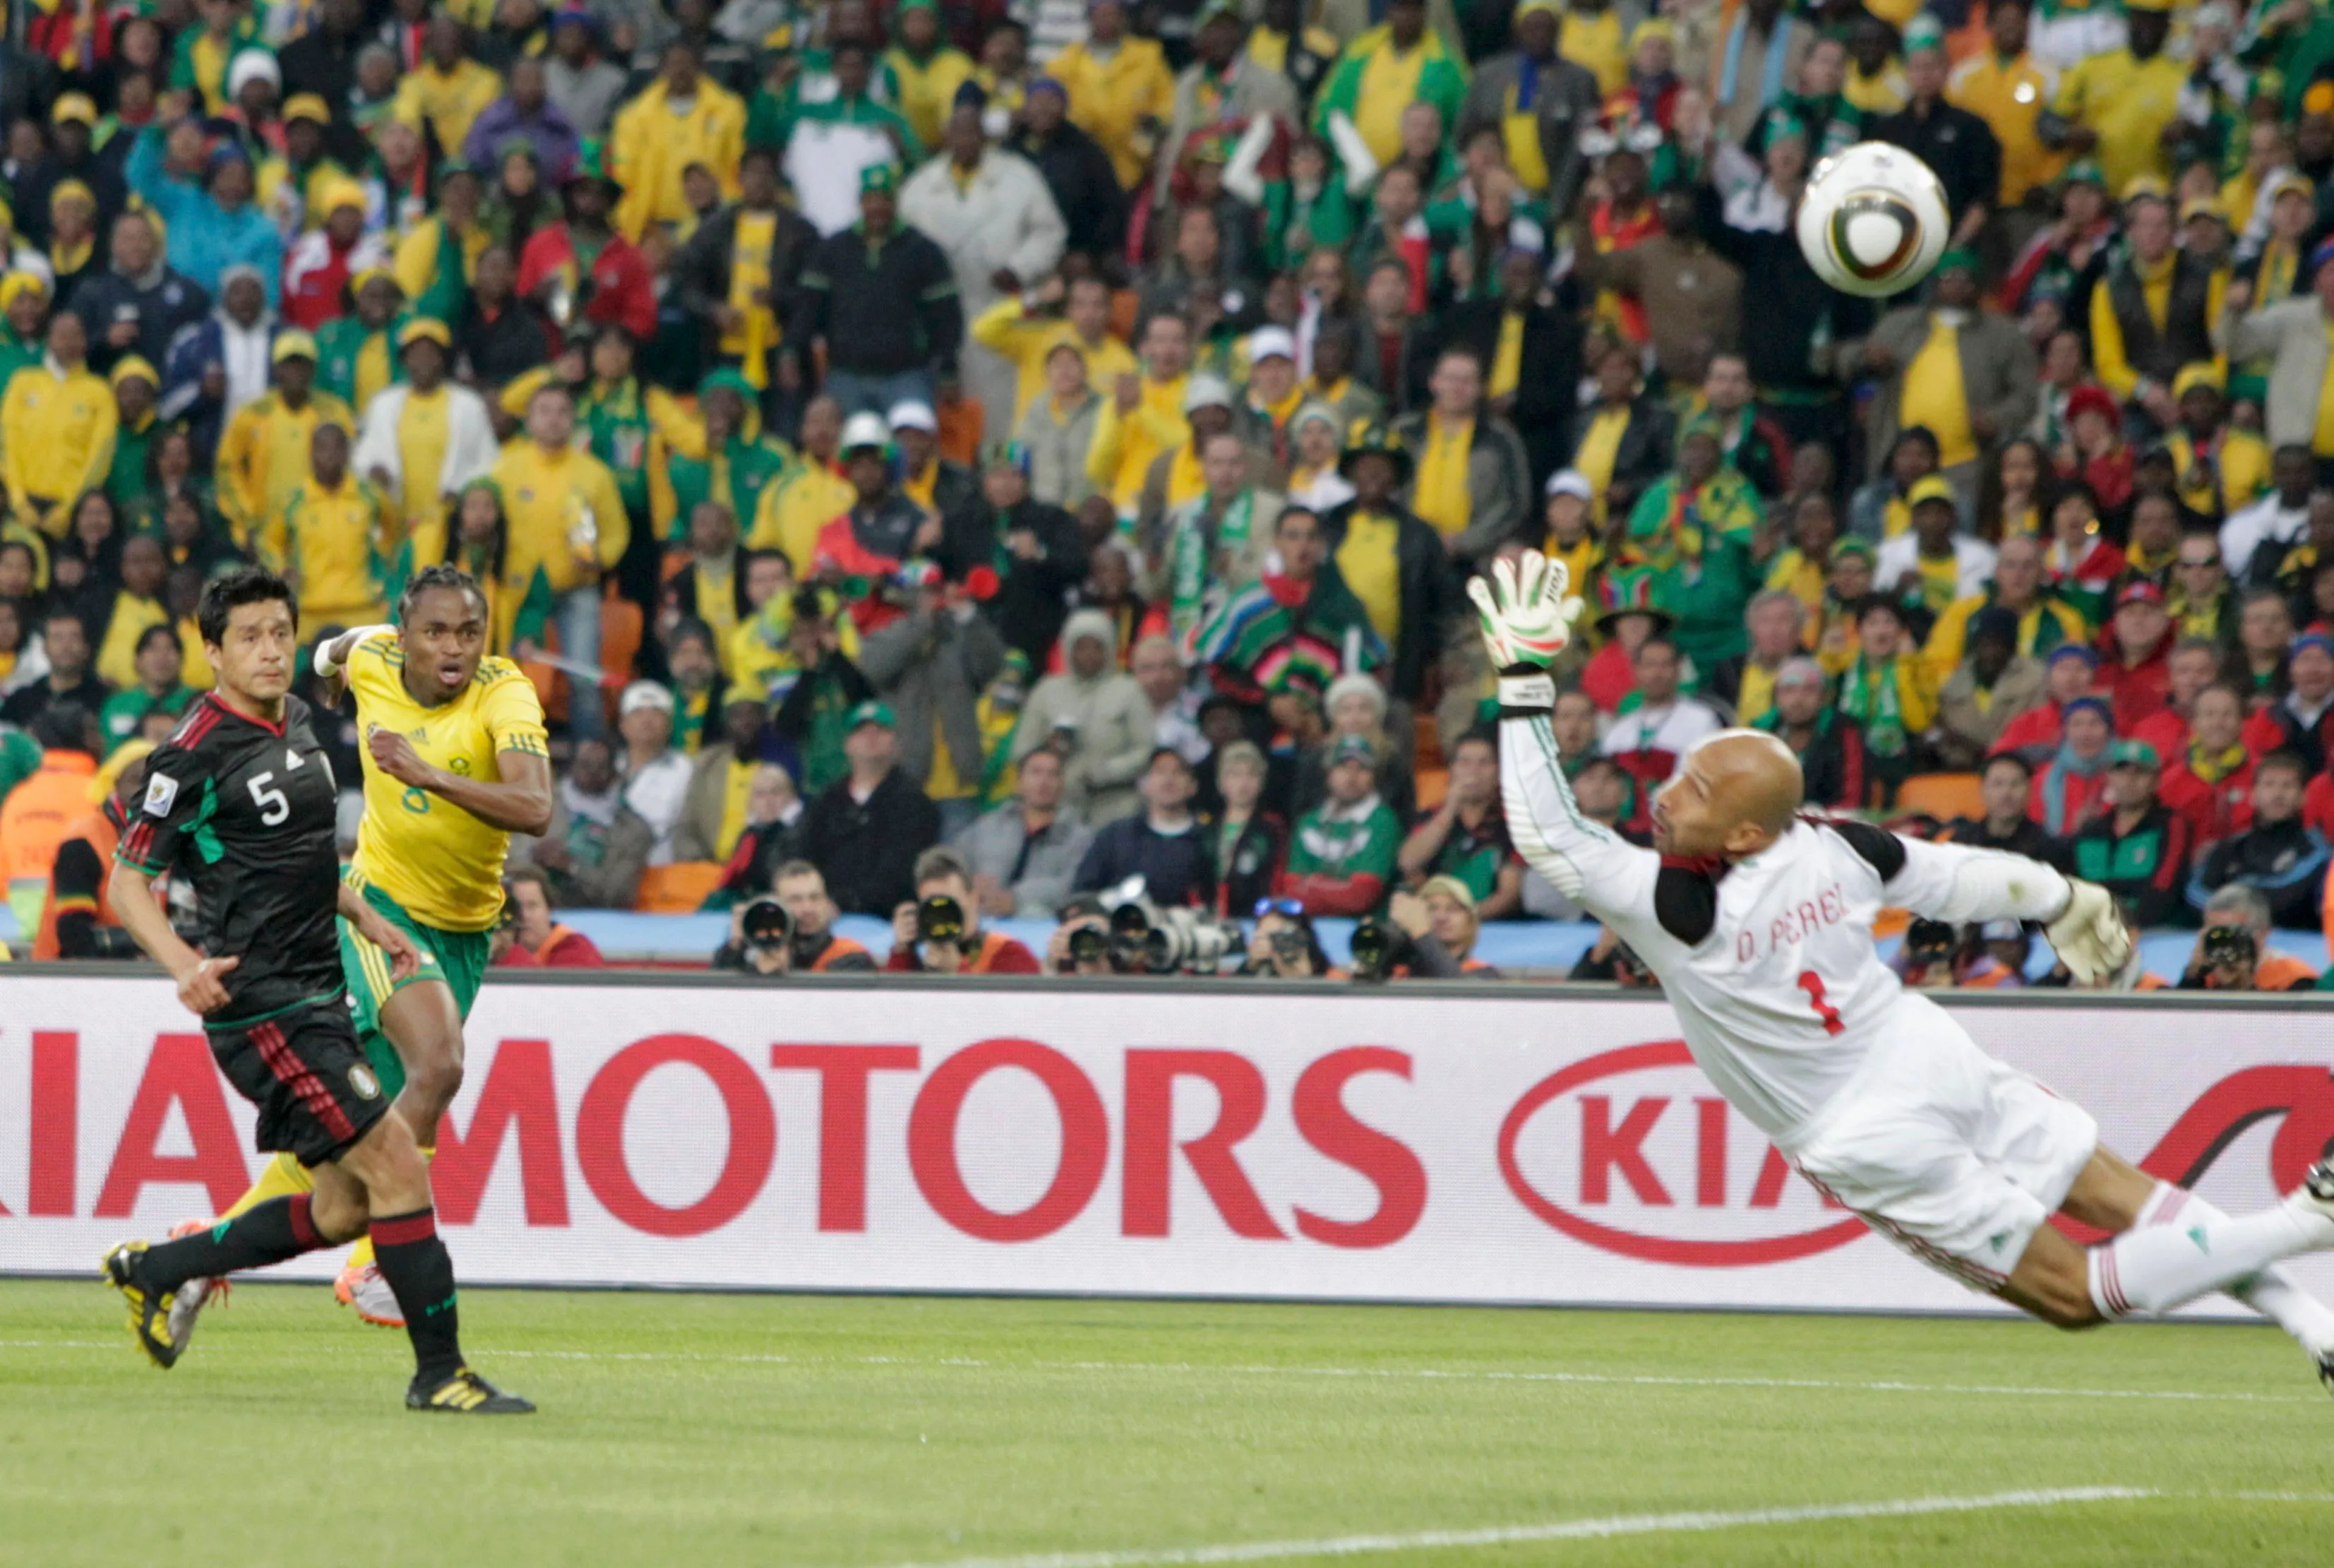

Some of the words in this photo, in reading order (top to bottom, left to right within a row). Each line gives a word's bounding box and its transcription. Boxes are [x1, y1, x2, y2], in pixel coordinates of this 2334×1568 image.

[246, 770, 290, 827] 5
[1797, 969, 1846, 1038] 1
[0, 1030, 253, 1219] IA
[428, 1032, 1428, 1250] MOTORS
